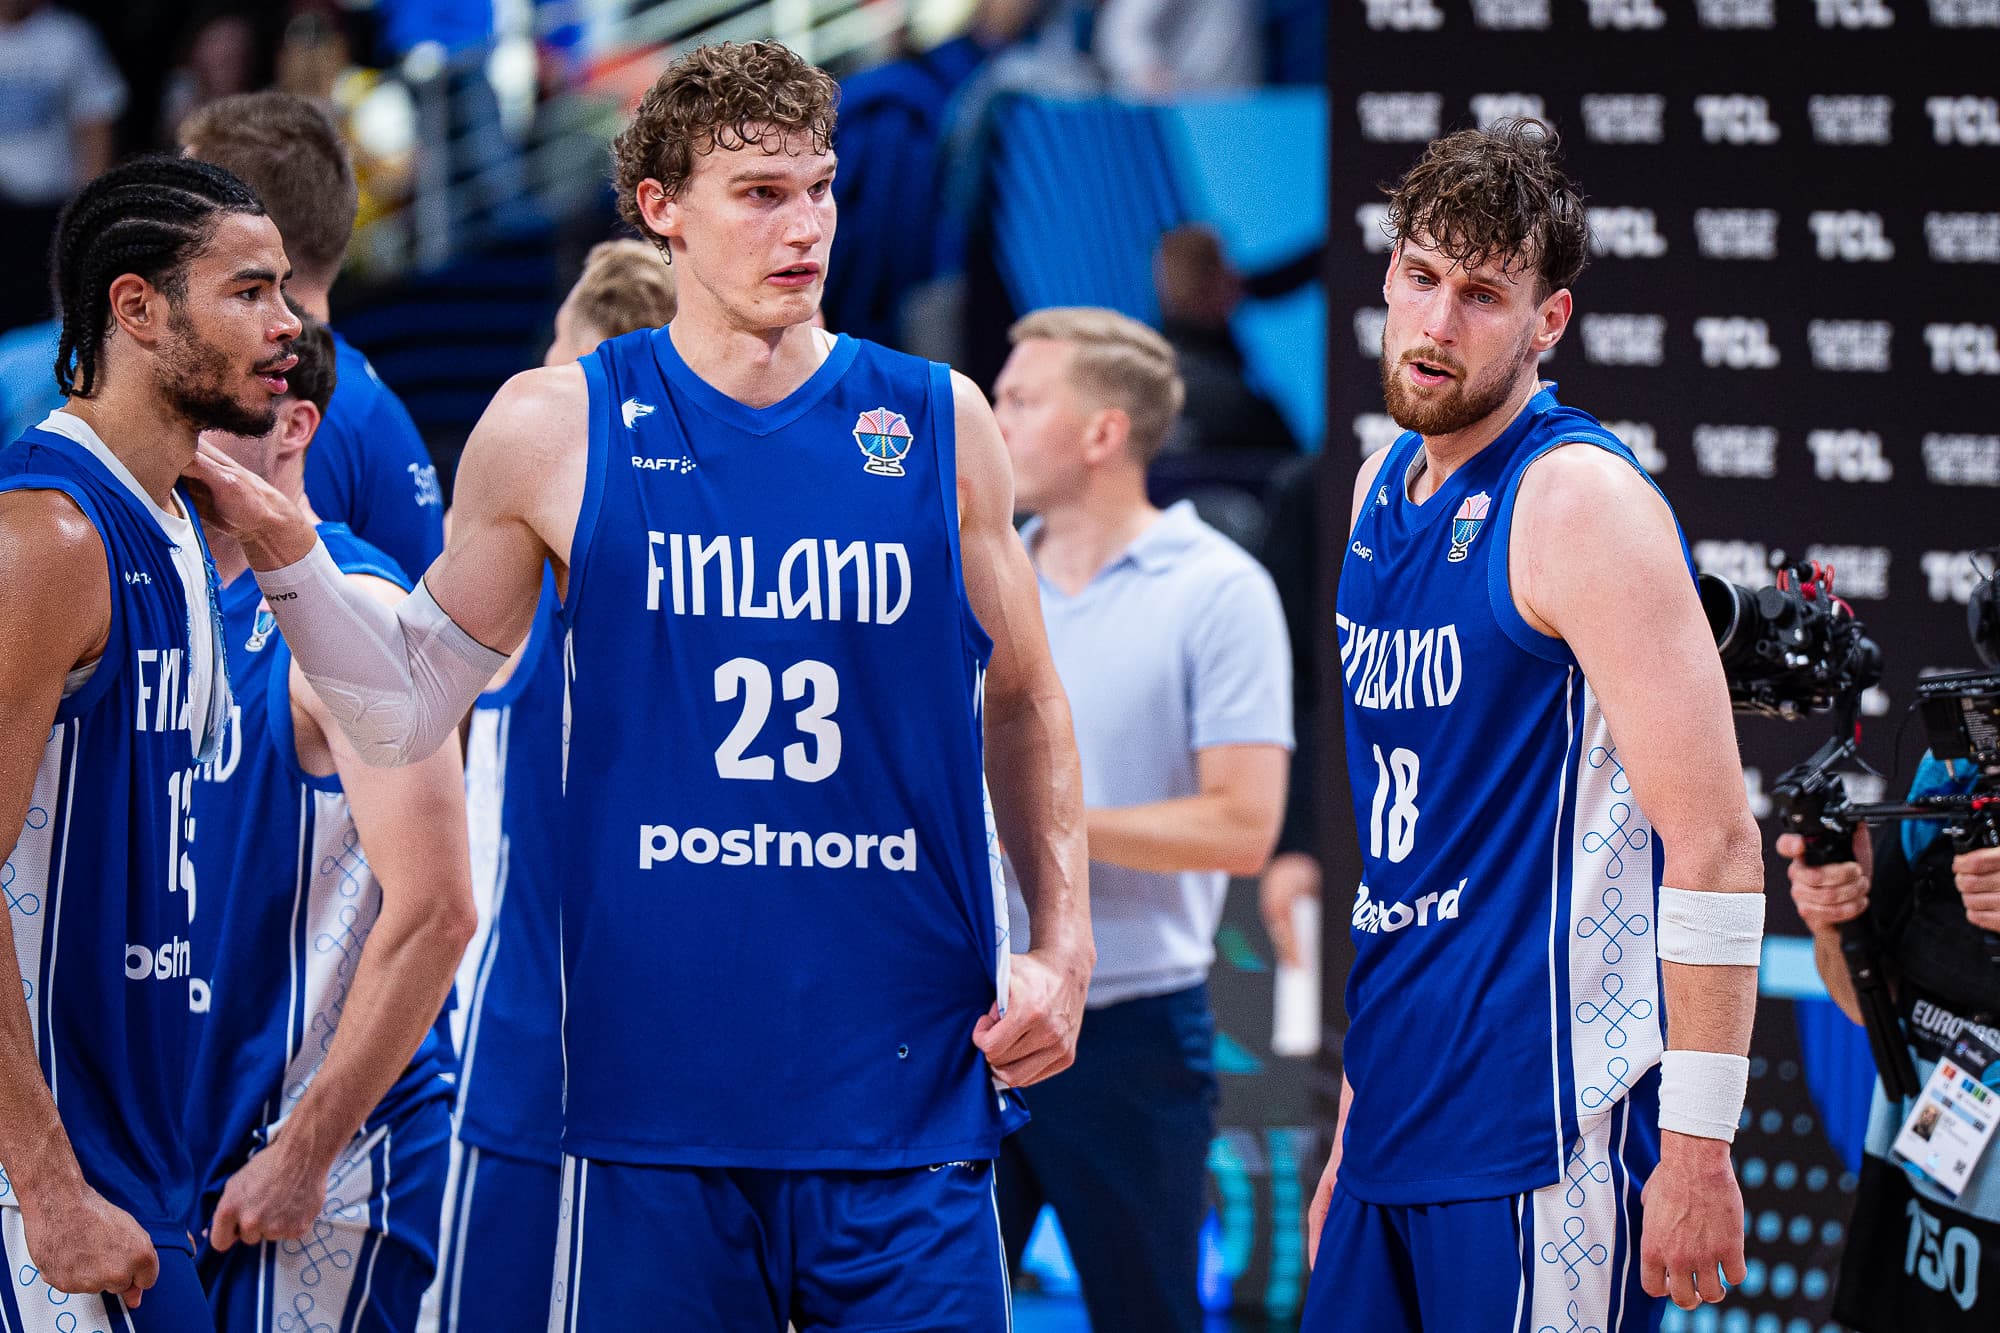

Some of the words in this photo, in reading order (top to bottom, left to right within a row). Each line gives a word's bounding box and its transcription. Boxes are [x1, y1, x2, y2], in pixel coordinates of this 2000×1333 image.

[1695, 94, 1780, 144] TCL
[1925, 95, 2000, 145] TCL
[1809, 210, 1895, 260] TCL
[1694, 316, 1780, 369] TCL
[1923, 322, 2000, 374] TCL
[1807, 429, 1893, 482] TCL
[646, 530, 912, 625] FINLAND
[714, 657, 842, 783] 23
[1370, 743, 1420, 864] 18
[639, 823, 917, 872] postnord
[1905, 1198, 1981, 1311] 150
